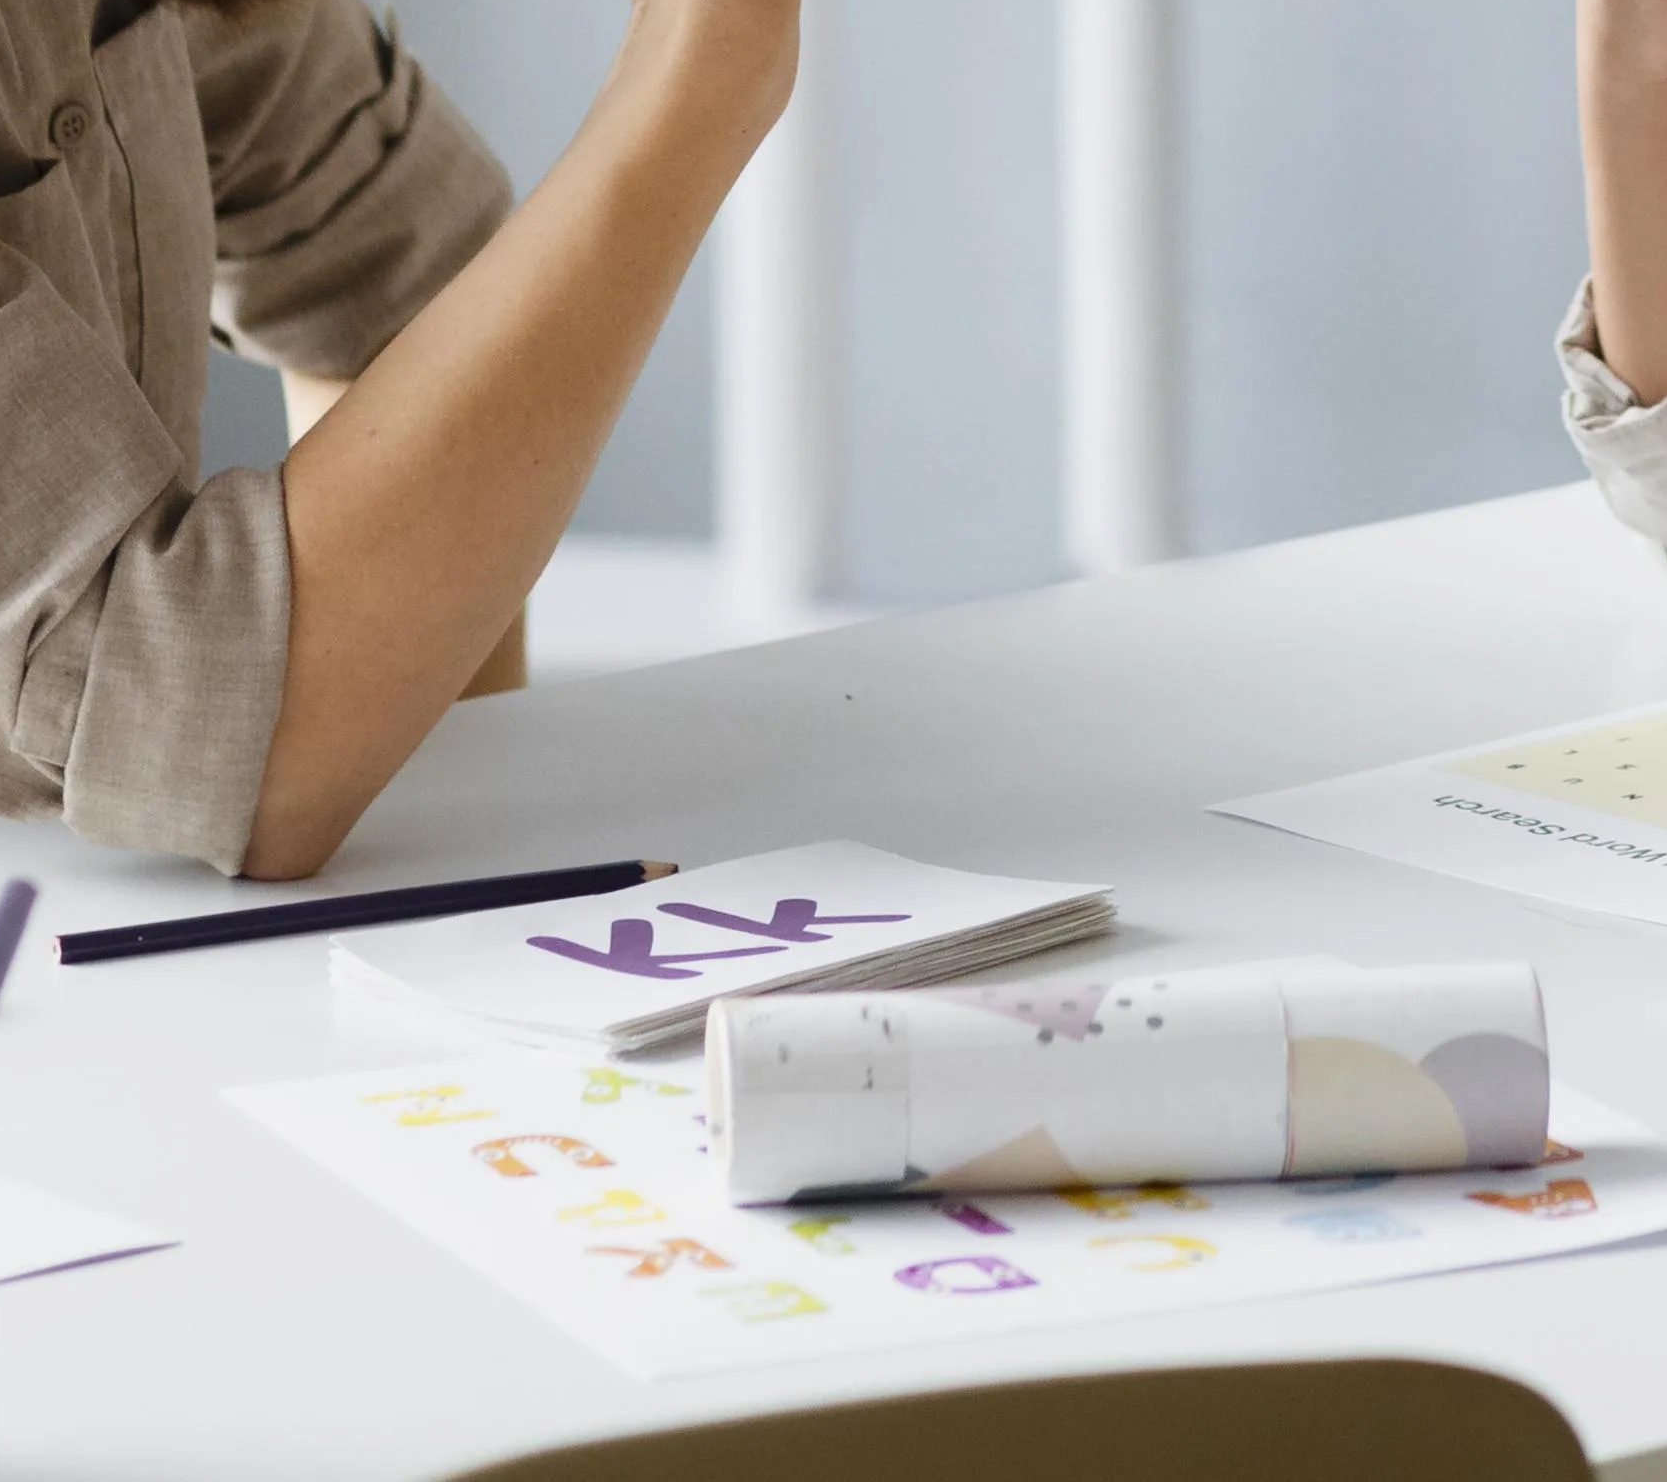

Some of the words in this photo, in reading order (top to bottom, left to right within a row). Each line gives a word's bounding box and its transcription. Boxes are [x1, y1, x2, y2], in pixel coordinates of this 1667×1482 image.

[1433, 794, 1567, 837] Search
[360, 1083, 499, 1127] Z
[579, 1067, 694, 1103] Y
[470, 1133, 617, 1177] U
[1465, 1176, 1599, 1219] A
[584, 1237, 735, 1278] K
[1087, 1233, 1218, 1272] C
[891, 1254, 1041, 1295] D
[699, 1281, 829, 1323] E
